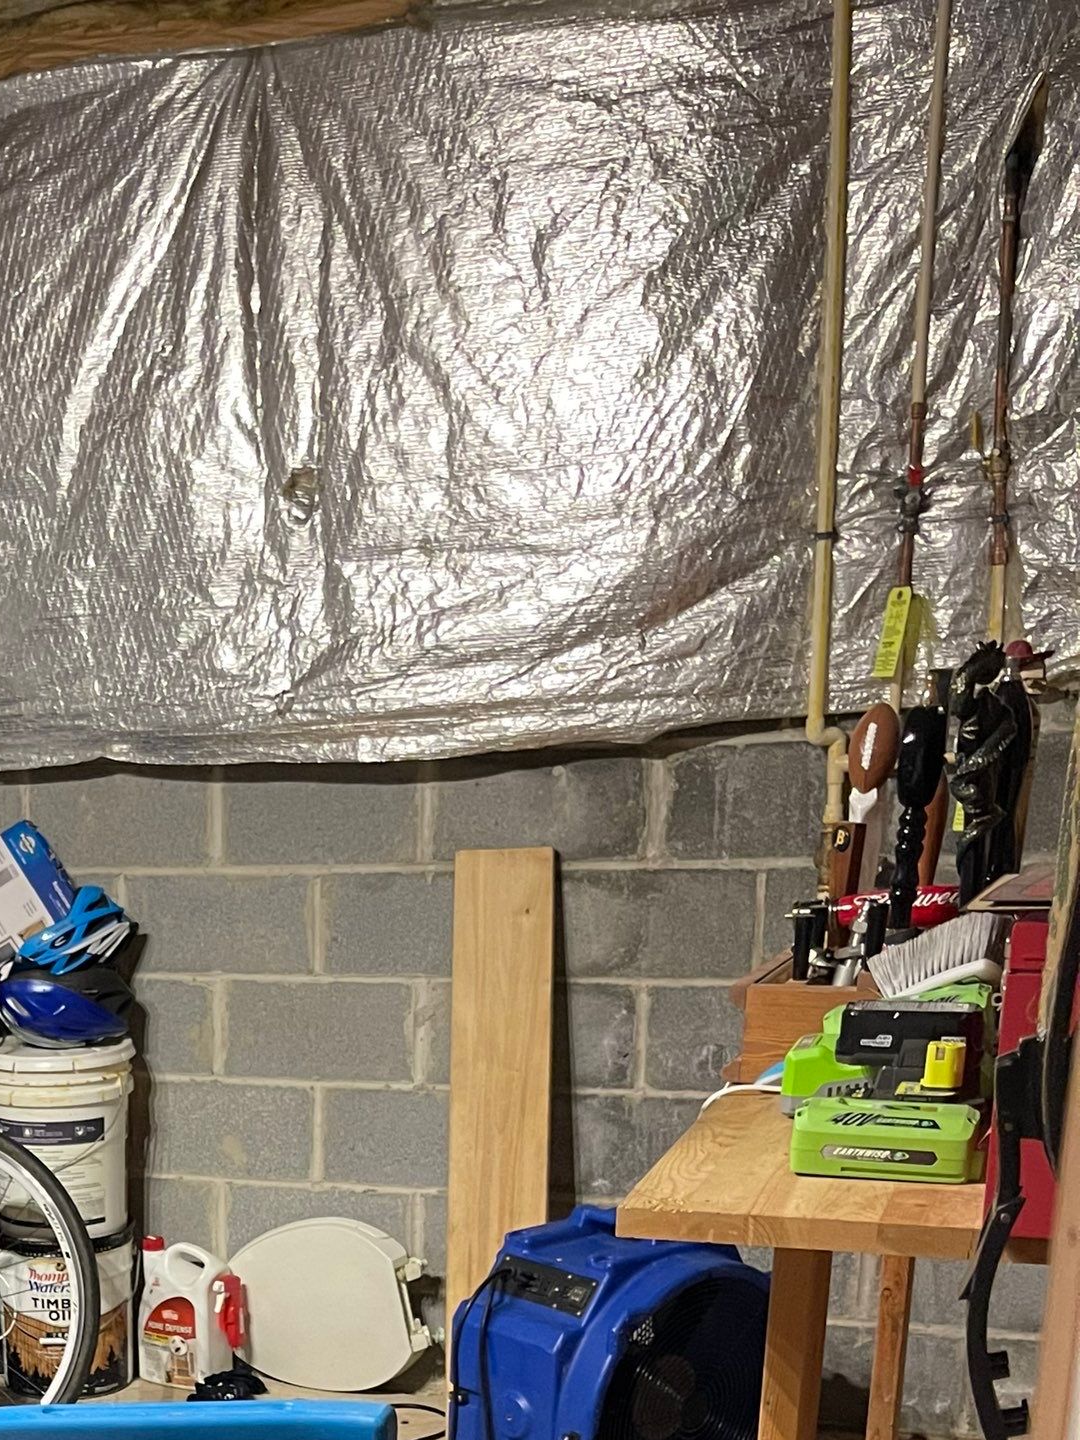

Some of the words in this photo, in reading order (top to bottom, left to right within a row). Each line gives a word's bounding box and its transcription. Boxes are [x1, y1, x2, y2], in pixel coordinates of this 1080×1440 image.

[830, 1111, 882, 1127] 40V
[31, 1297, 71, 1309] TIMB
[165, 1323, 193, 1334] DEFENSE
